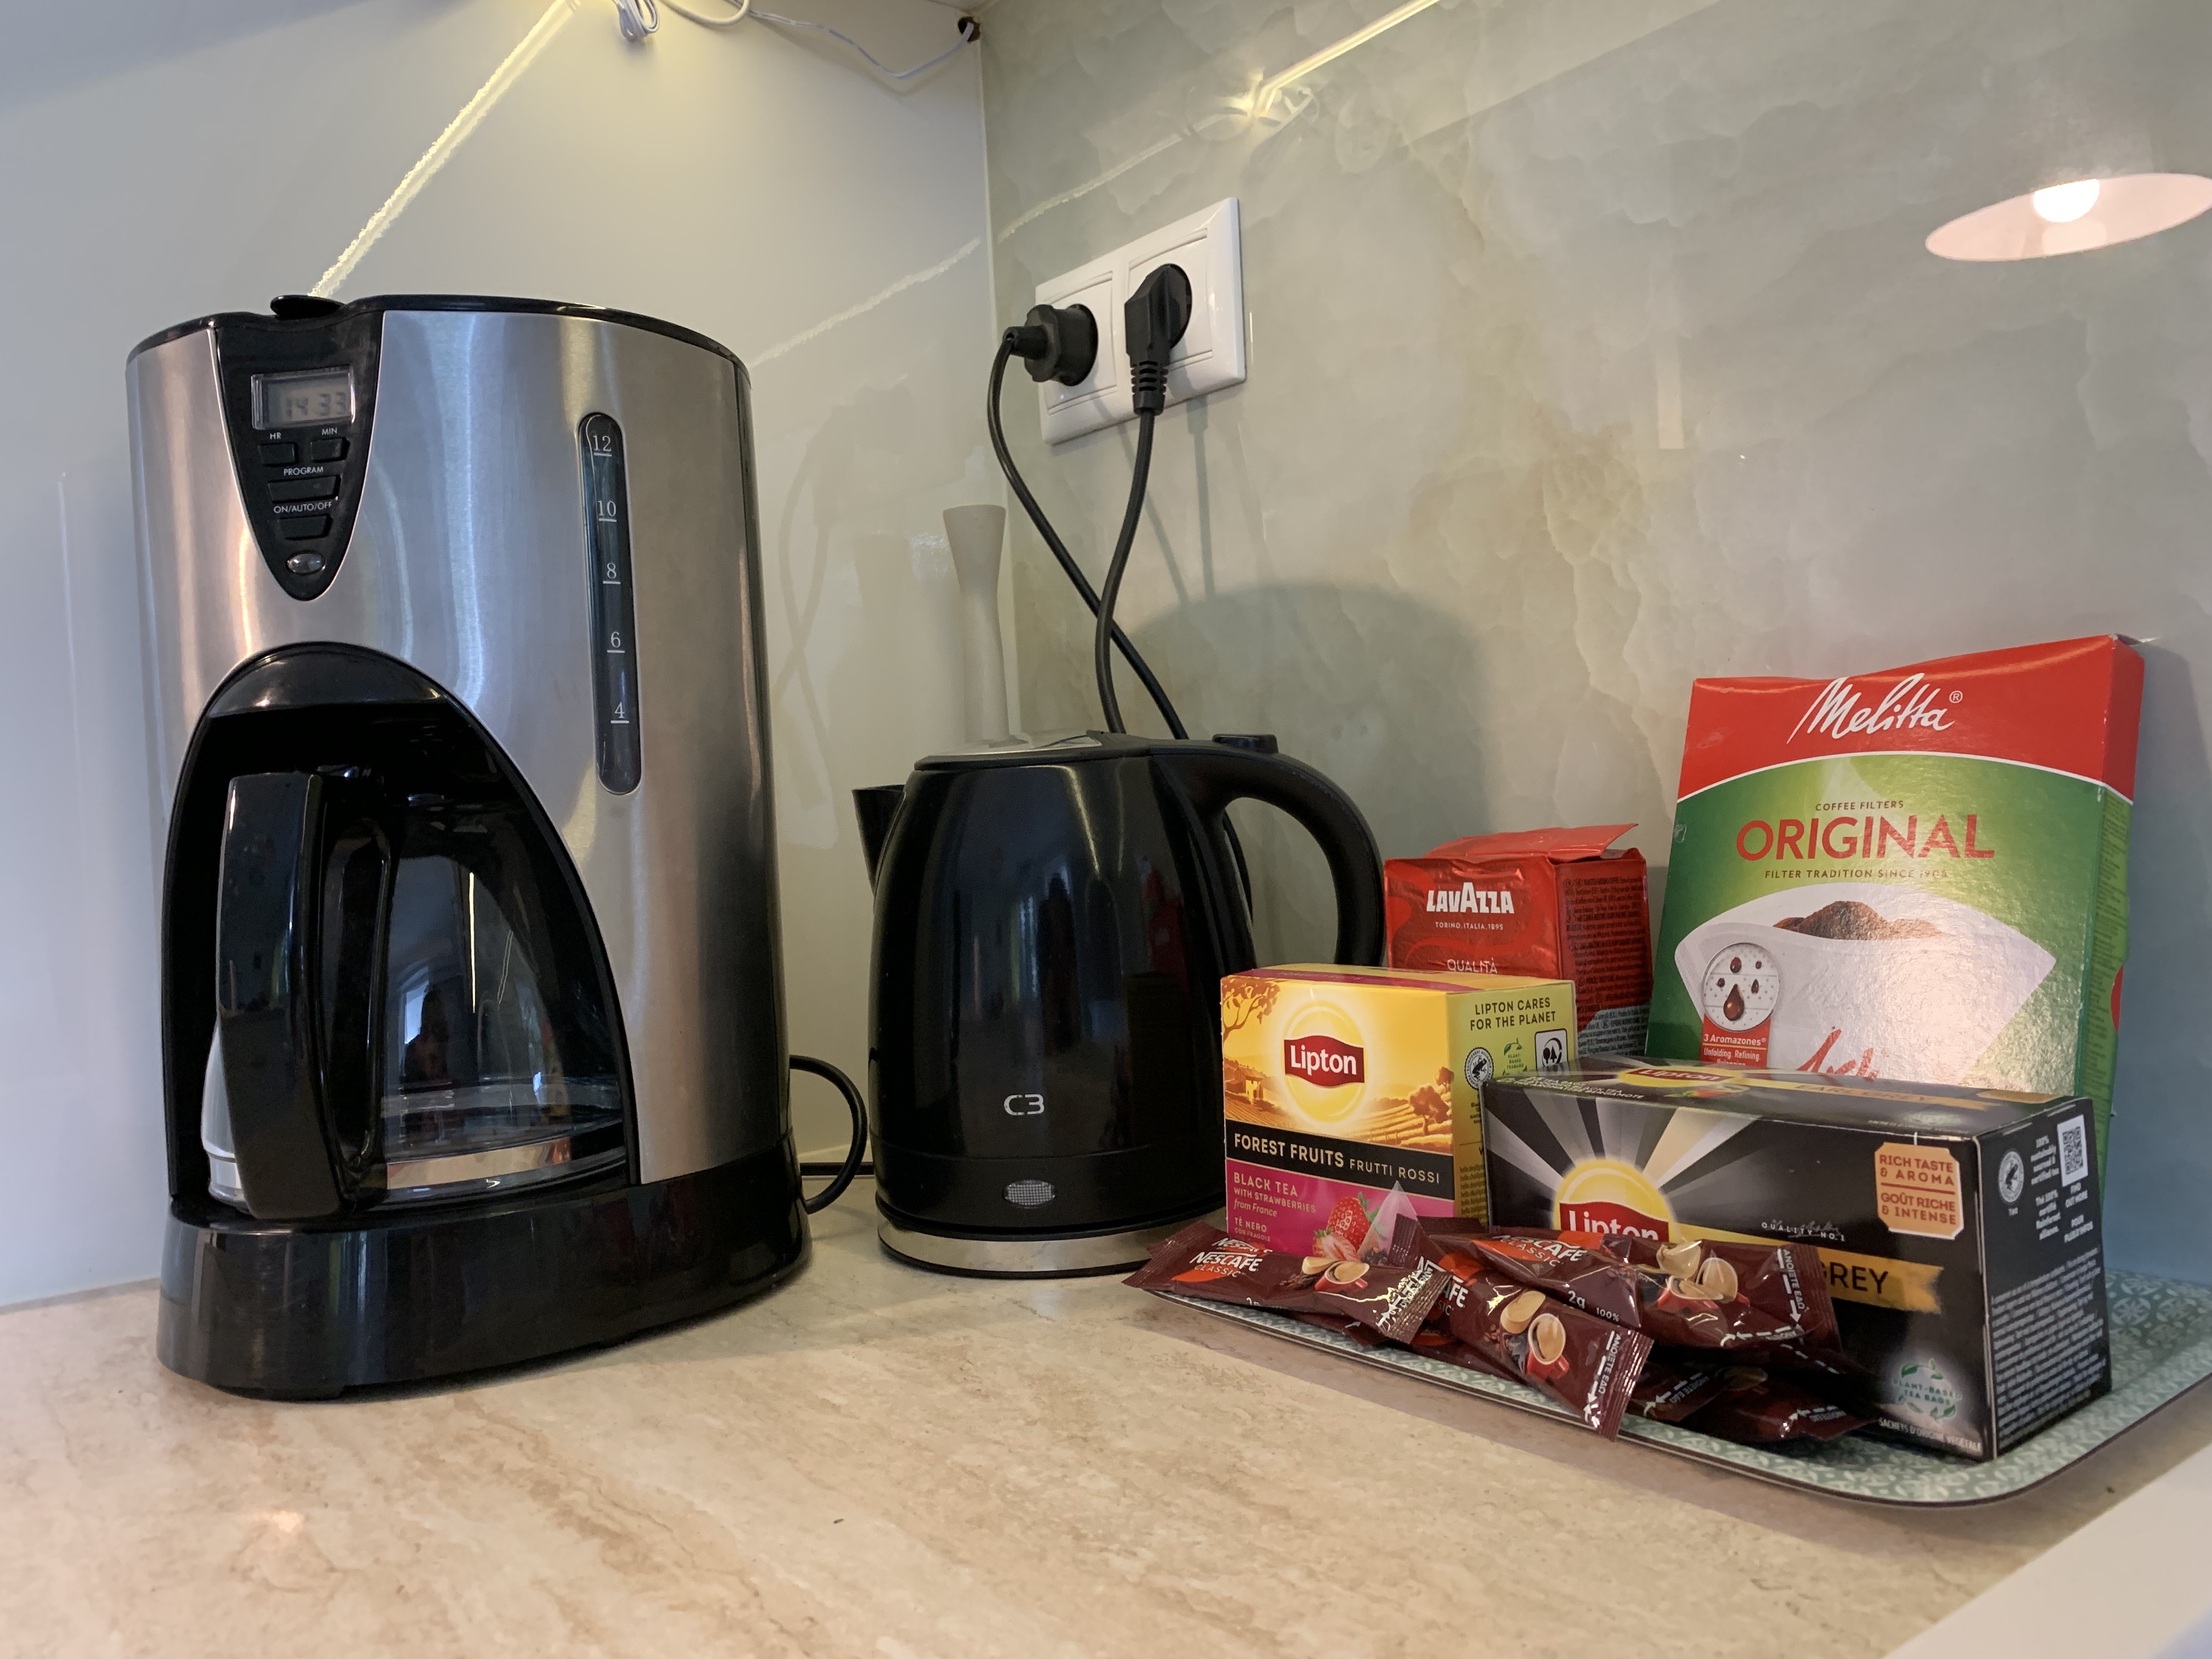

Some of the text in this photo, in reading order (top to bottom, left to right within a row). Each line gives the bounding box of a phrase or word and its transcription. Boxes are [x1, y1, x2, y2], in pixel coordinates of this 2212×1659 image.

[321, 427, 338, 436] MIN
[592, 435, 612, 452] 12
[284, 466, 324, 476] PROGRAM
[273, 501, 332, 514] ON/AUTO/OFF
[597, 500, 617, 517] 10
[607, 562, 617, 579] 8
[611, 631, 621, 648] 6
[614, 701, 625, 718] 4
[1815, 799, 1904, 811] COFFEE FILTERS
[1736, 814, 1995, 861] ORIGINAL
[1765, 870, 1801, 878] FILTER
[1807, 869, 1873, 878] TRADITION
[1878, 869, 1915, 878] SINCE
[1426, 882, 1515, 914] LAVAZZA
[1447, 957, 1498, 974] QUALITÀ
[1475, 997, 1550, 1015] LIPTON CARES
[1470, 1011, 1556, 1031] FOR THE PLANET
[1703, 1034, 1709, 1042] 3
[1290, 1045, 1357, 1076] Lipton
[1638, 1069, 1720, 1081] Lipton
[1003, 1093, 1045, 1116] C3
[1234, 1133, 1440, 1184] FOREST FRUITS FRUTTI ROSSI
[1879, 1154, 1954, 1173] RICH TASTE
[1234, 1172, 1298, 1197] BLACK TEA
[1880, 1167, 1954, 1186] & AROMA
[1233, 1198, 1277, 1217] from France
[1234, 1187, 1316, 1213] WITH STRAWBERRIES
[1881, 1192, 1955, 1212] GOÛT RICHE
[1882, 1205, 1956, 1225] & INTENSE
[1234, 1227, 1245, 1235] CON
[1245, 1220, 1267, 1233] NERO
[1761, 1221, 1813, 1235] QUALITY
[1500, 1238, 1560, 1267] CLASSIC
[1194, 1263, 1242, 1278] CLASSIC
[1821, 1260, 1888, 1295] REY
[1567, 1290, 1585, 1310] 2g
[1595, 1307, 1620, 1323] 100%
